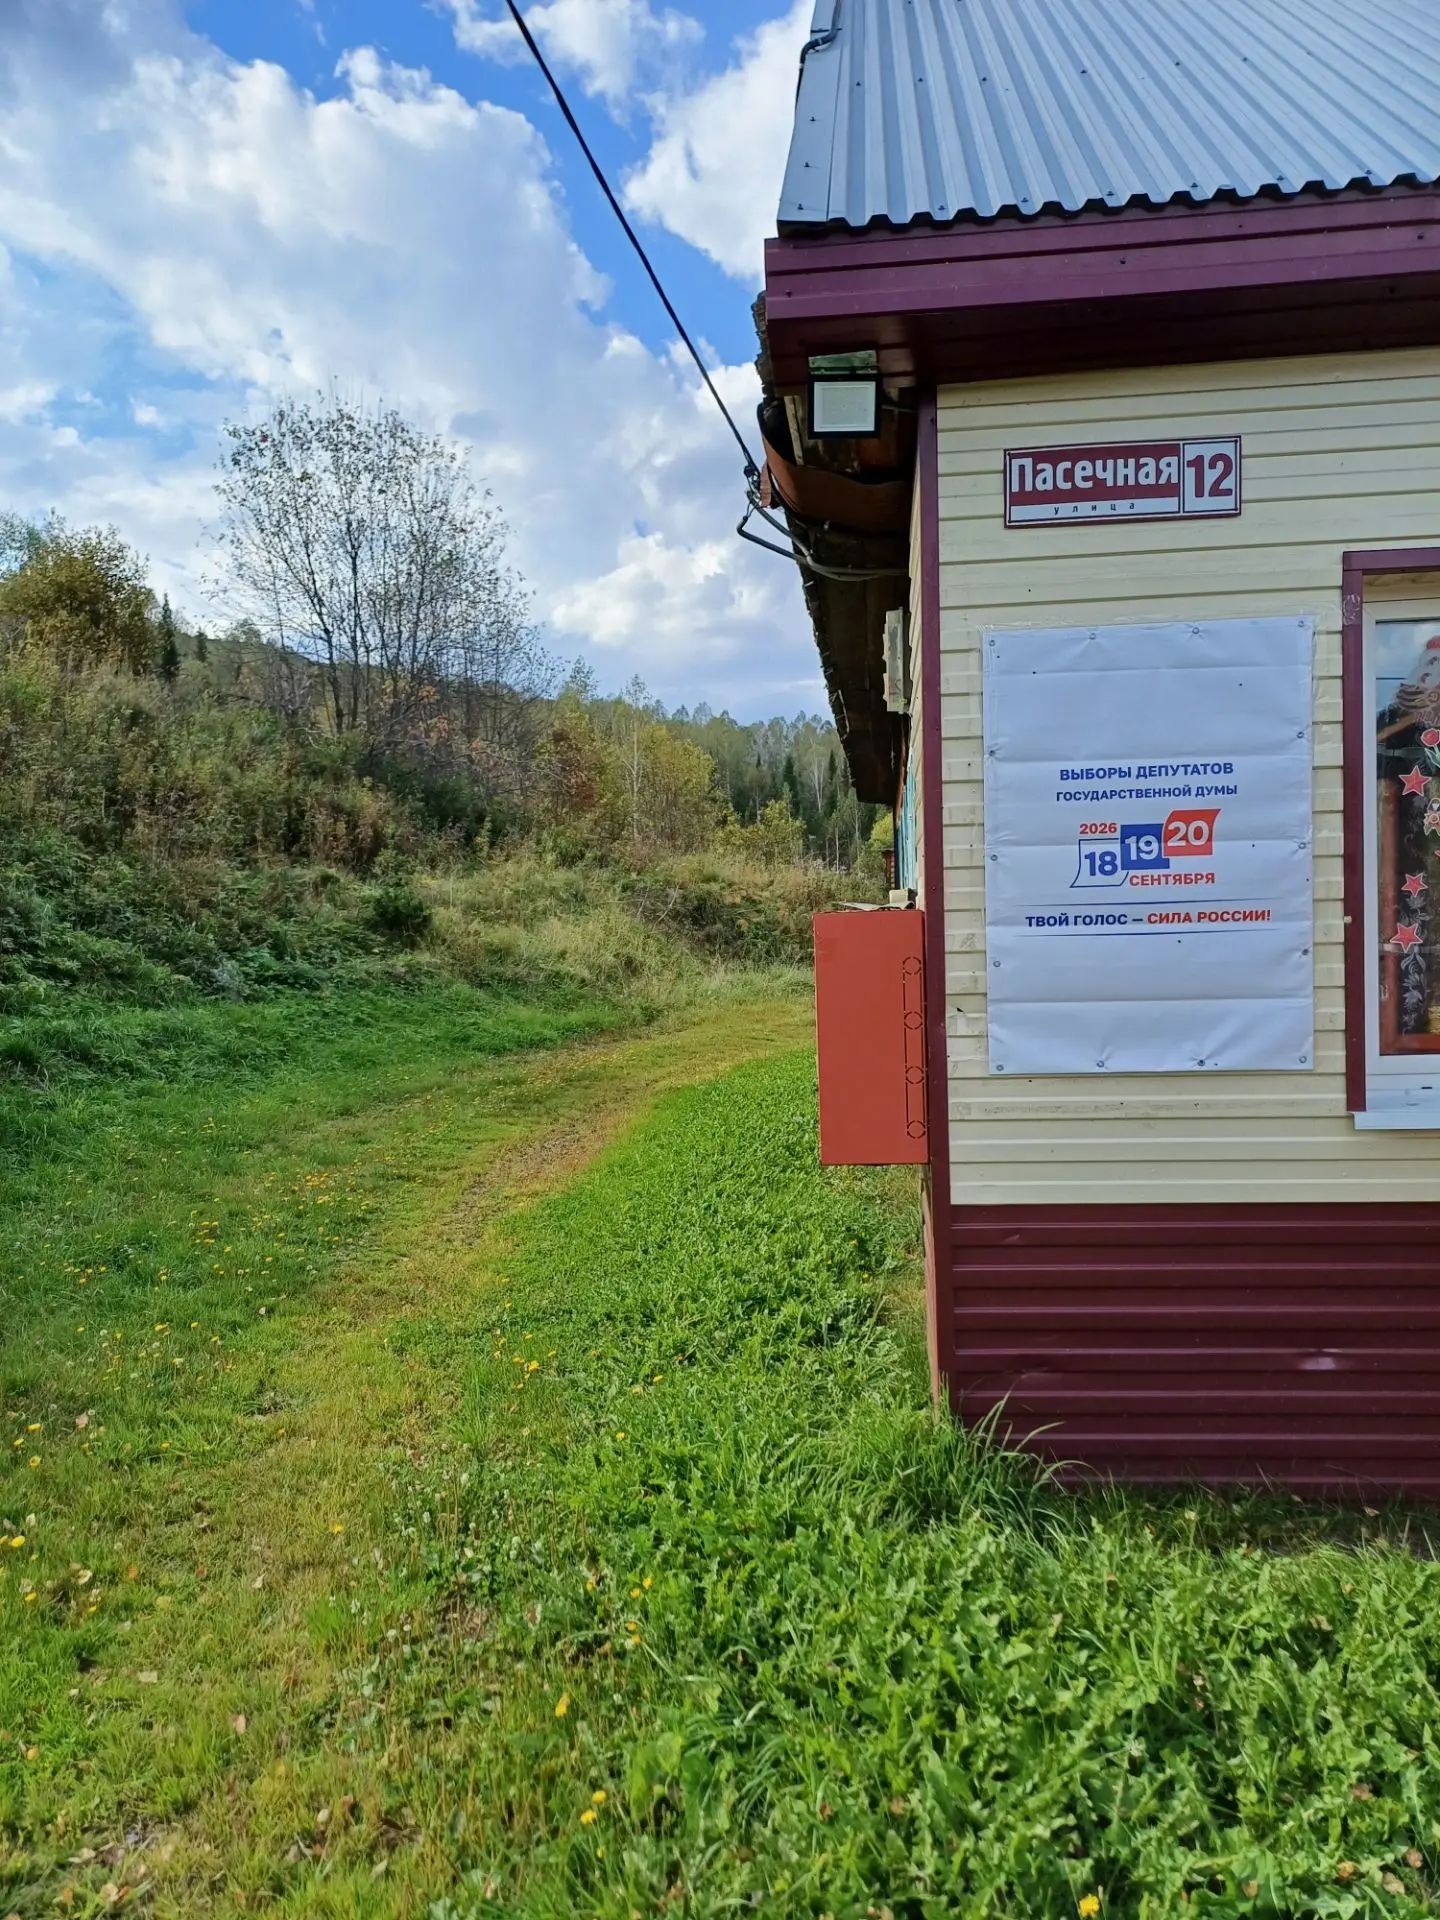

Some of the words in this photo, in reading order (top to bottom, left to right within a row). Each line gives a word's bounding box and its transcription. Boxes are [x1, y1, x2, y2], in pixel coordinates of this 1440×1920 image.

[1011, 456, 1178, 492] Пасечная
[1187, 453, 1233, 498] 12
[1054, 501, 1135, 515] улица
[1060, 767, 1132, 781] ВЫБОРЫ
[1136, 762, 1234, 780] ДЕПУТАТОВ
[1056, 785, 1192, 802] ГОСУДАРСТВЕННОЙ
[1195, 785, 1238, 798] ДУМЫ
[1079, 823, 1117, 835] 2026
[1084, 851, 1118, 877] 18
[1125, 834, 1159, 861] 19
[1167, 820, 1209, 847] 20
[1129, 873, 1215, 887] СЕНТЯБРЯ
[1026, 913, 1068, 928] ТВОЙ
[1074, 914, 1128, 926] ГОЛОС
[1147, 912, 1193, 925] СИЛА
[1198, 910, 1271, 923] РОССИИ!
